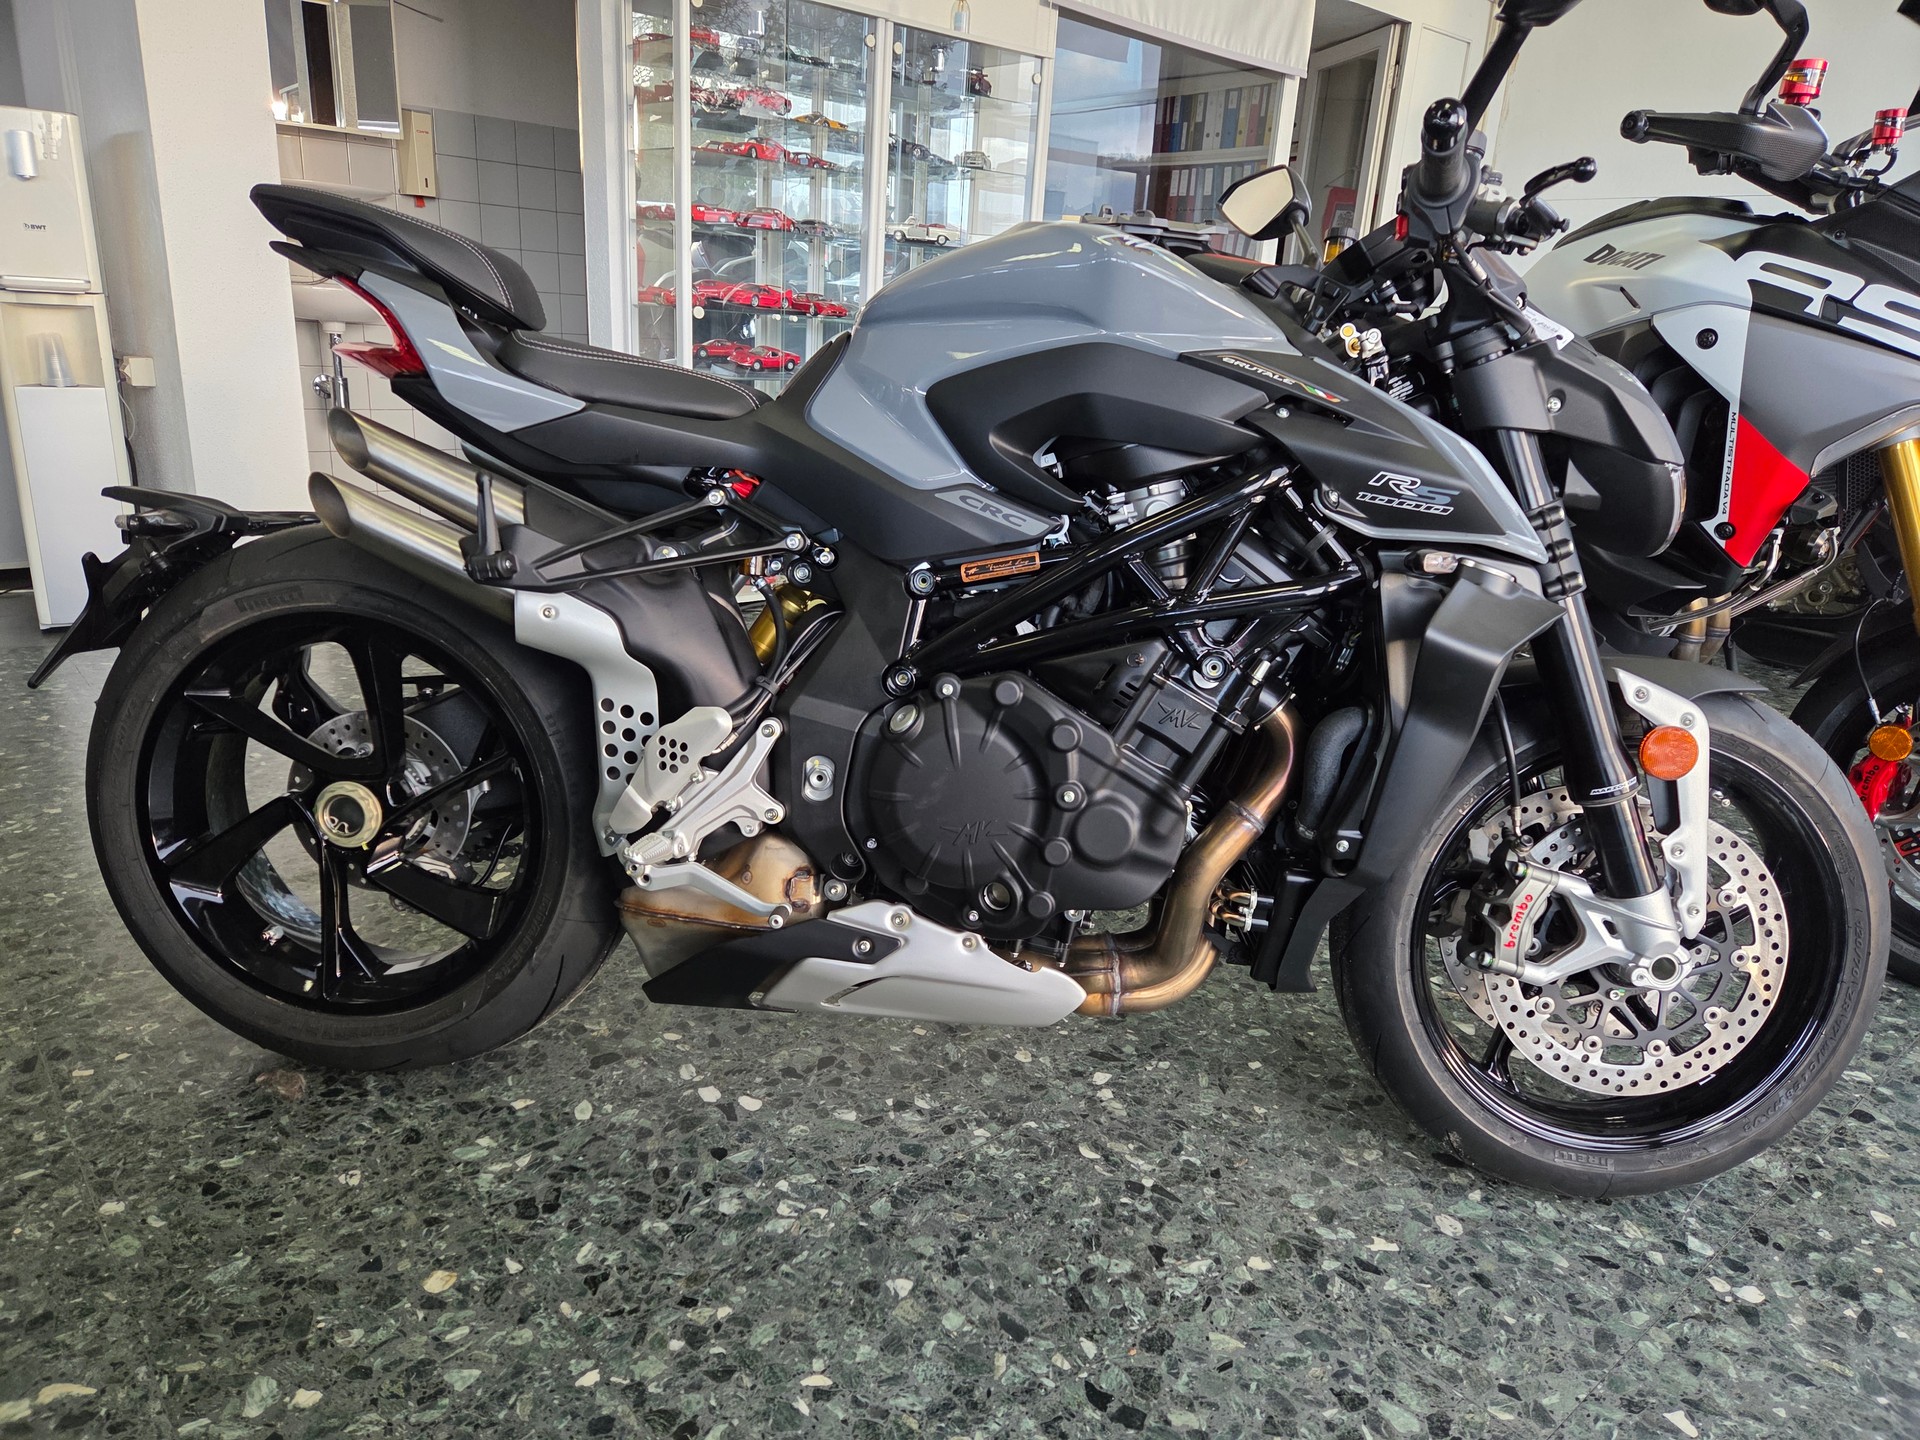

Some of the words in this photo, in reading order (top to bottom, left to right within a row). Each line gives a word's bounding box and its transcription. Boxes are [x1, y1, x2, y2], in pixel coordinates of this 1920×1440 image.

[1583, 243, 1667, 271] DUCATI
[1222, 357, 1296, 386] BRUTALE
[1722, 411, 1737, 499] MULTISTRADA
[1367, 470, 1461, 505] RS
[958, 495, 1028, 528] CRC
[1355, 491, 1455, 516] 1000
[1721, 501, 1729, 515] V4
[1503, 894, 1533, 949] brembo
